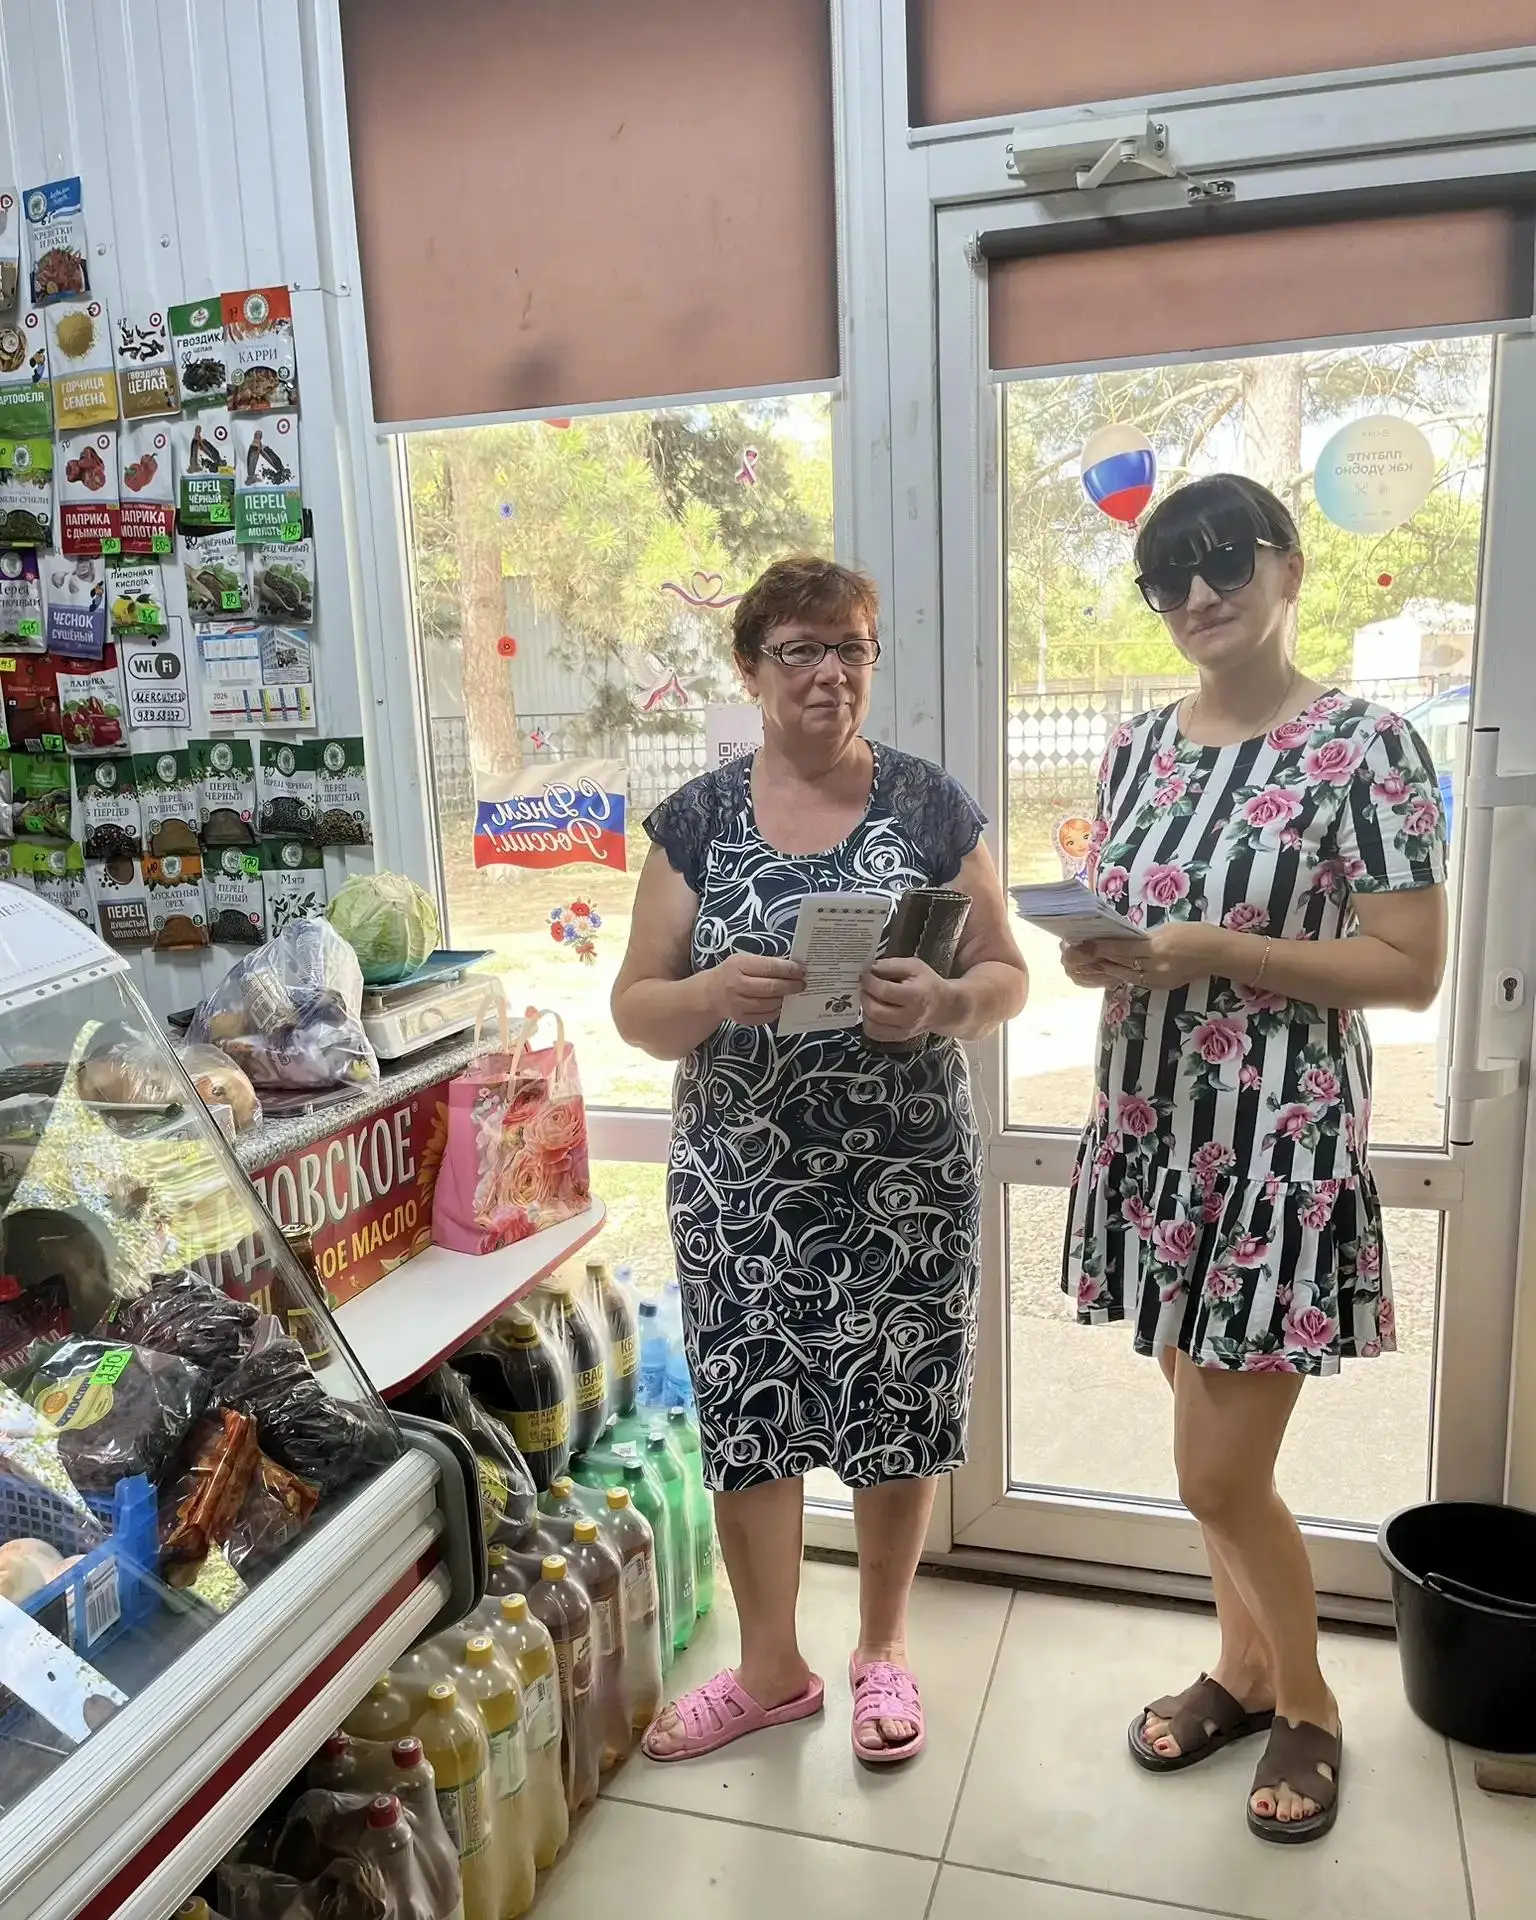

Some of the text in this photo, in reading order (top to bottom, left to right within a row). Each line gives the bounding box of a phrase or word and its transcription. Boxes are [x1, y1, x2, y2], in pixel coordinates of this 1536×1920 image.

[238, 348, 279, 364] КАРРИ
[127, 368, 165, 381] ГВОЗДИКА
[61, 377, 105, 395] ГОРЧИЦА
[128, 376, 168, 394] ЦЕЛАЯ
[0, 391, 45, 406] АРТОФЕЛЯ
[63, 391, 107, 410] СЕМЕНА
[188, 480, 222, 493] ПЕРЕЦ
[189, 504, 211, 513] МОЛОТ
[244, 494, 287, 511] ПЕРЕЦ
[65, 513, 111, 526] ПАПРИКА
[66, 527, 112, 540] С ДЫМКОМ
[248, 526, 283, 538] МОЛОТЫ
[111, 568, 154, 580] ЛИМОННАЯ
[115, 578, 149, 588] КИСЛОТА
[53, 611, 94, 629] ЧЕСНОК
[134, 660, 174, 673] Wi Fi
[209, 782, 239, 793] ПЕРЕЦ
[324, 783, 348, 793] ПЕРЕЦ
[159, 794, 183, 804] ПЕРЕЦ
[205, 791, 243, 801] ЧЕРНЫЙ
[93, 807, 130, 818] ПЕРЦЕВ
[147, 802, 194, 815] ДУШИСТЫЙ
[281, 873, 305, 886] Мята
[151, 887, 200, 901] МУСКАТНЫЙ
[218, 884, 245, 894] ПЕРЕЦ
[107, 903, 146, 919] ПЕРЕЦ
[165, 900, 185, 909] ОРЕХ
[110, 918, 148, 929] ДУШИСТЫЙ
[112, 927, 150, 939] МОЛОТЫЙ
[352, 1199, 418, 1263] МАСЛО
